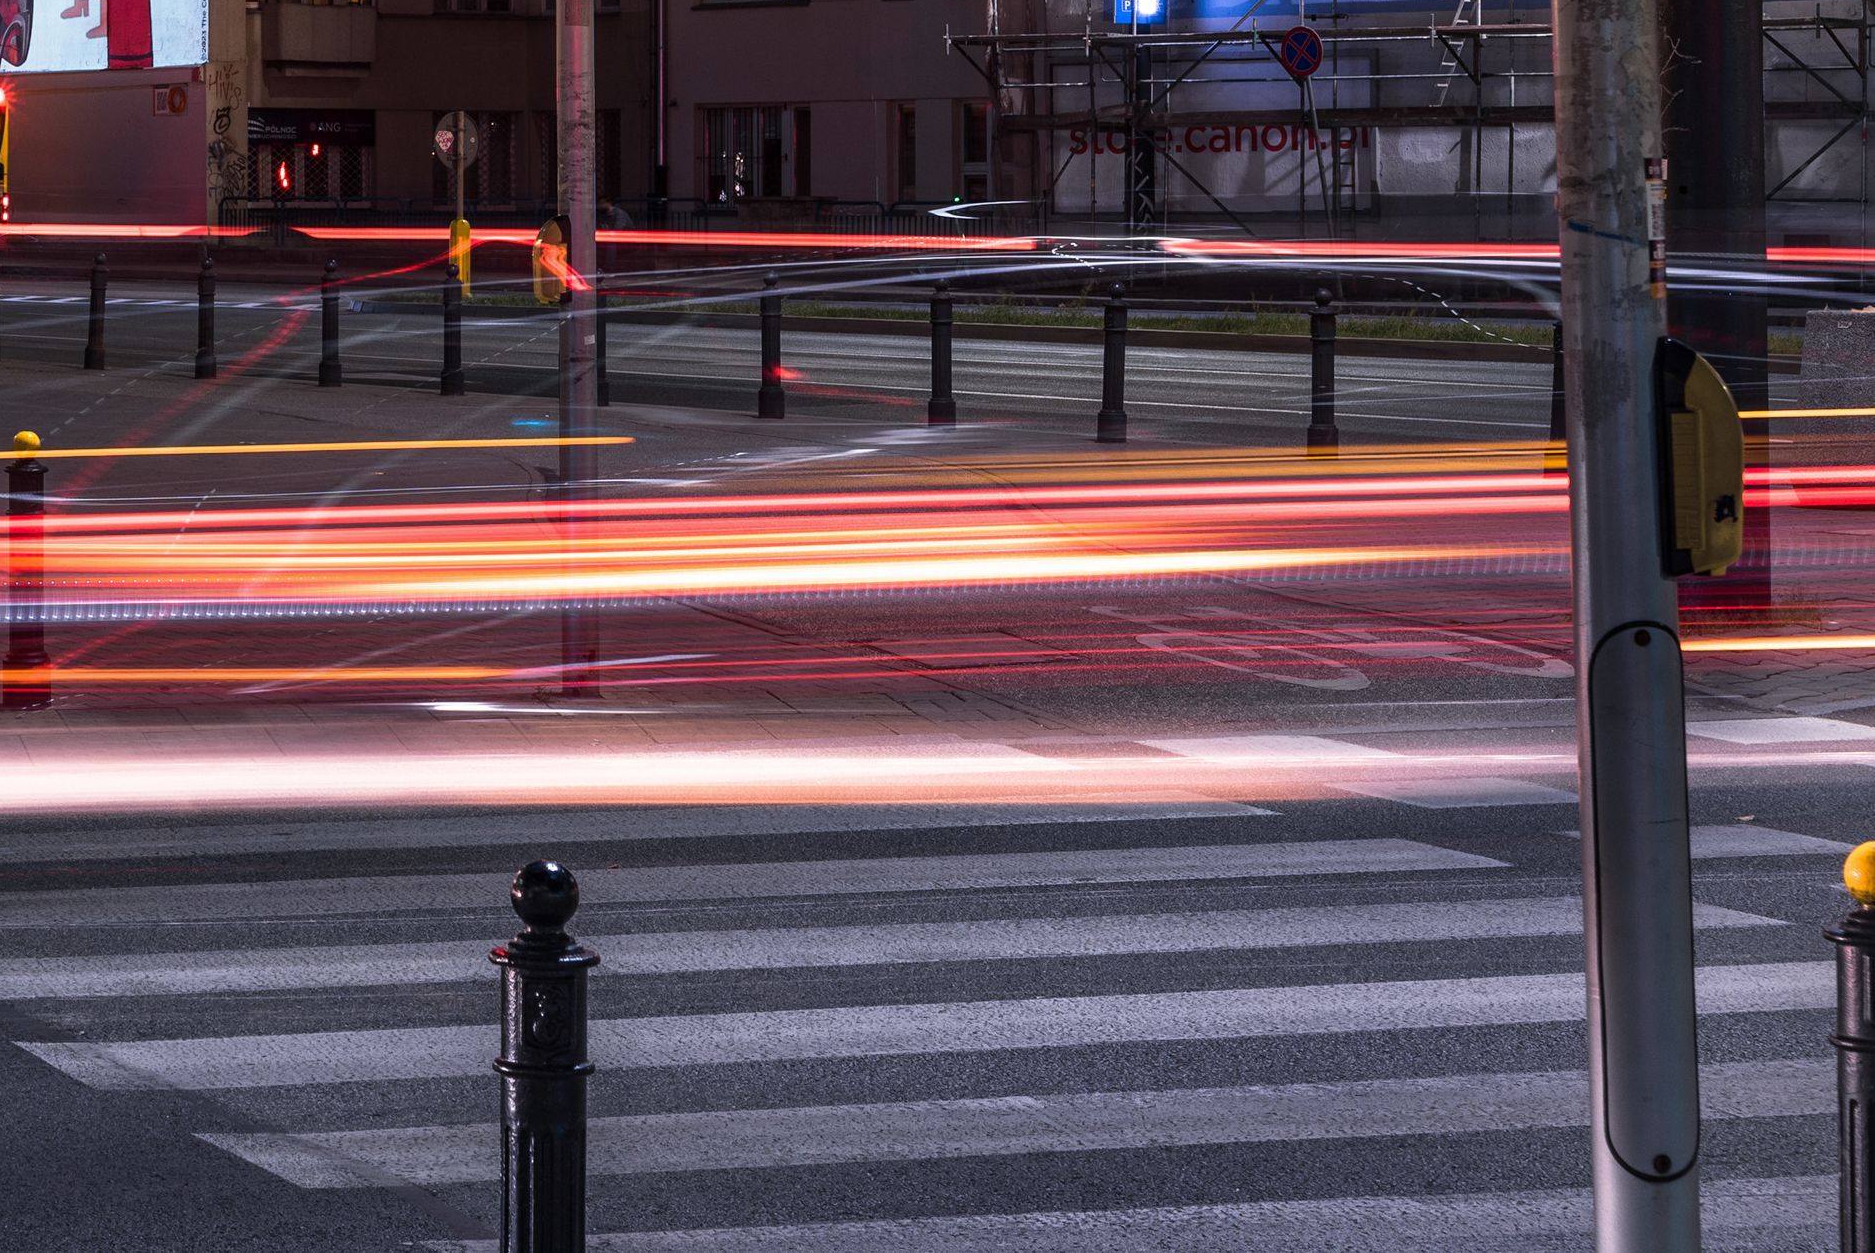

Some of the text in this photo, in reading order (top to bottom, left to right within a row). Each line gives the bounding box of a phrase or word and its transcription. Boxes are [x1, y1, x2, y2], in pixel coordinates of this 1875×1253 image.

[265, 122, 298, 134] PÓŁNOC
[317, 122, 342, 132] ANG
[1069, 123, 1370, 155] stoe.canon.pl
